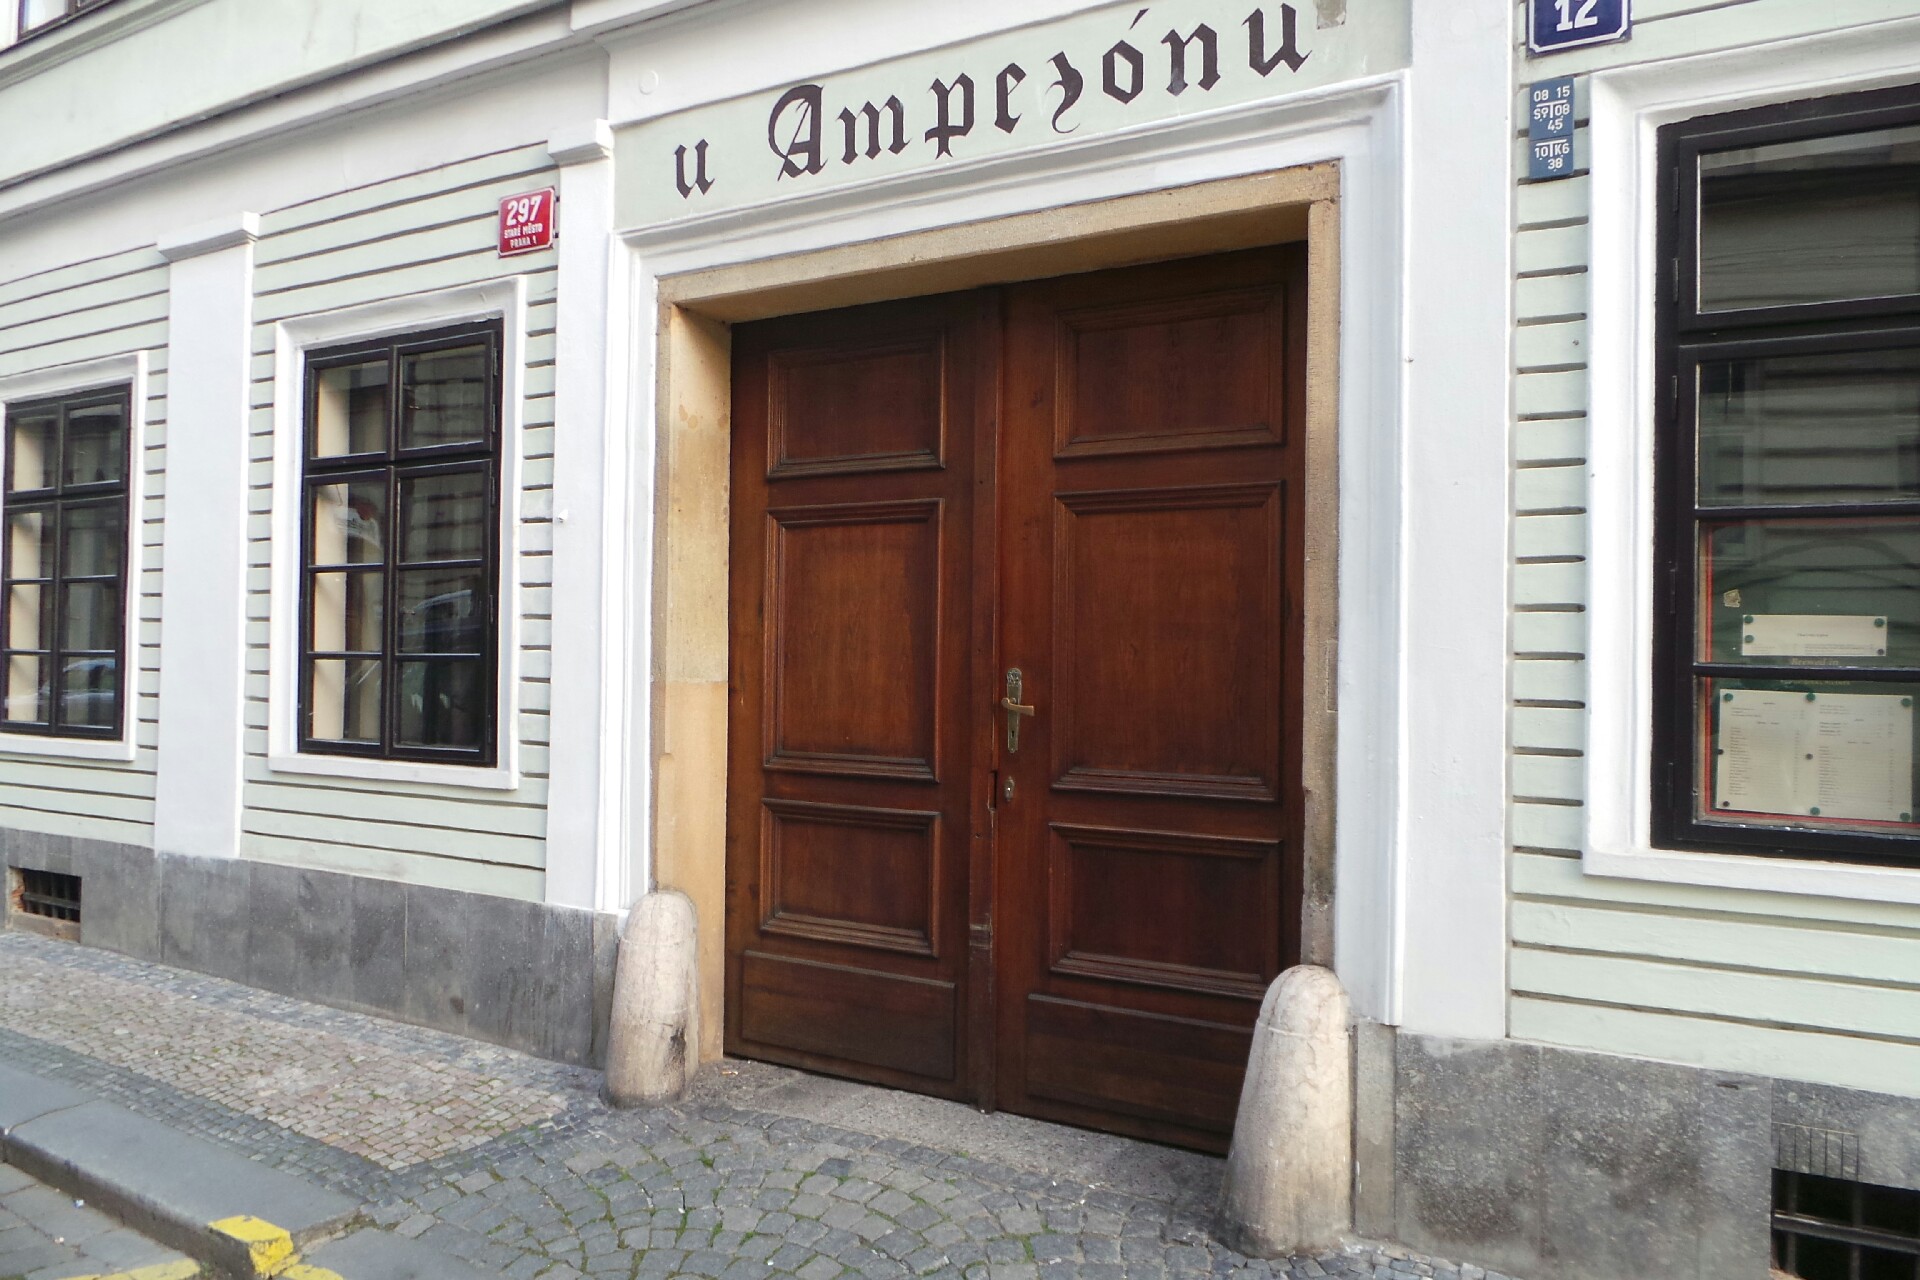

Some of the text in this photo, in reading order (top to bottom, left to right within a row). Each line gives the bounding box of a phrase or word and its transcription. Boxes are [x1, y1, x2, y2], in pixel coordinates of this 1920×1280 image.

[1554, 0, 1598, 32] 12
[674, 2, 1313, 199] u Ampezónu
[1534, 85, 1570, 102] 08 15
[1548, 157, 1563, 170] 38
[506, 195, 542, 226] 297
[510, 235, 537, 248] PRAHA 1
